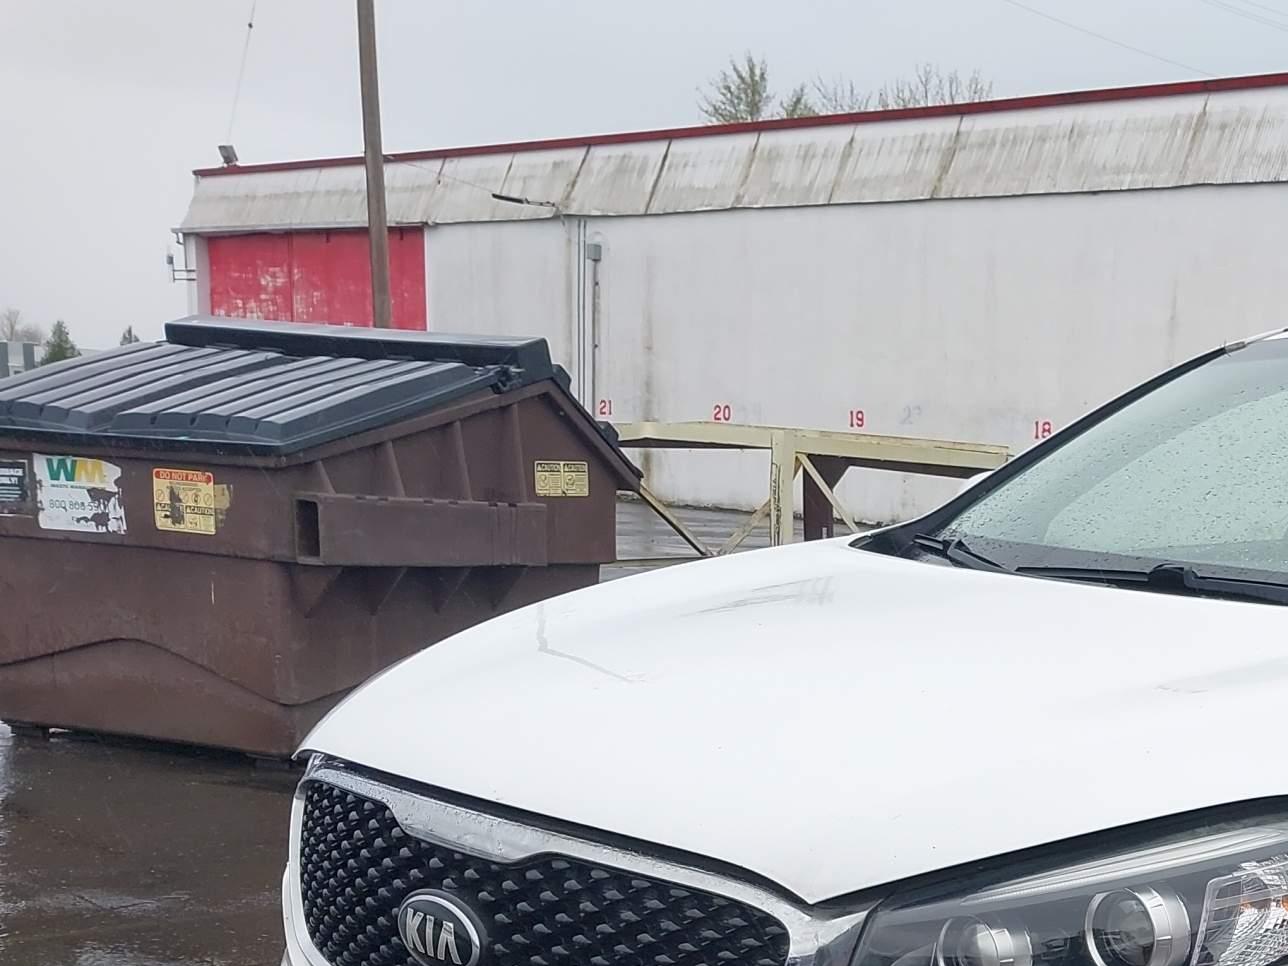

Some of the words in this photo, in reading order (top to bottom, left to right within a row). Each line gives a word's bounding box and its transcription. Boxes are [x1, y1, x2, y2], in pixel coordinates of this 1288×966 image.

[600, 400, 612, 415] 21
[713, 405, 731, 421] 20
[850, 410, 864, 428] 19
[1035, 421, 1051, 439] 18
[46, 458, 105, 481] WM
[159, 471, 170, 479] DO
[172, 472, 186, 480] NOT
[406, 907, 462, 966] KIA
